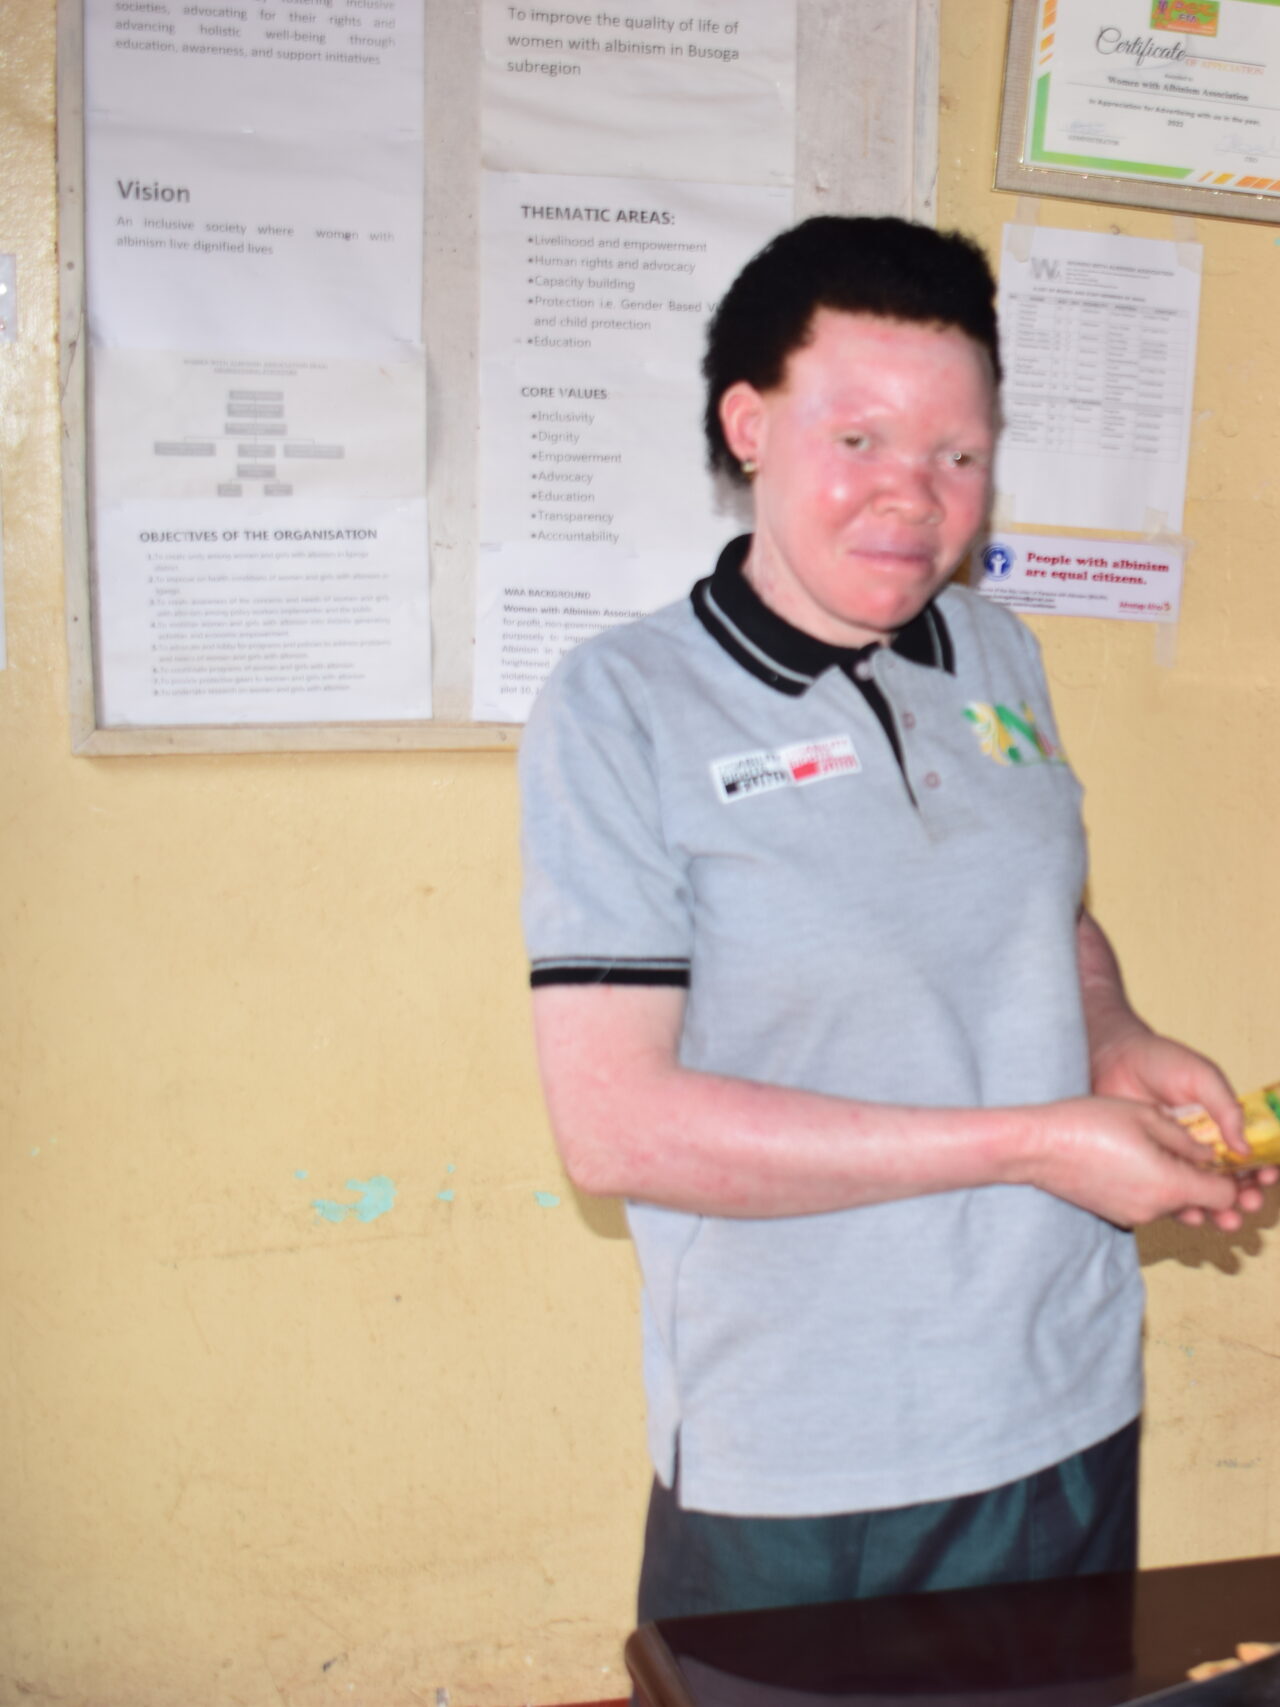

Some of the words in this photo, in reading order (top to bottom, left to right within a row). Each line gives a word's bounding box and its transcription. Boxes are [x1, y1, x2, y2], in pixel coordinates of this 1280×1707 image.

[183, 6, 248, 21] advocating
[260, 9, 276, 21] for
[289, 11, 317, 23] their
[329, 14, 362, 28] rights
[374, 18, 396, 29] and
[508, 8, 525, 21] To
[531, 9, 592, 26] improve
[597, 12, 620, 27] the
[625, 15, 676, 34] quality
[679, 18, 694, 32] of
[698, 19, 720, 34] life
[724, 21, 739, 35] of
[115, 19, 176, 35] advancing
[199, 23, 242, 37] holistic
[265, 28, 326, 44] well-being
[349, 34, 396, 48] through
[251, 46, 274, 59] and
[276, 49, 322, 63] support
[325, 51, 381, 65] initiatives
[508, 36, 563, 49] women
[568, 36, 600, 51] with
[604, 39, 666, 56] albinism
[671, 42, 683, 56] in
[688, 44, 739, 61] Busoga
[1096, 27, 1187, 67] Certificate
[507, 59, 581, 77] subregion
[1107, 75, 1139, 88] Women
[1142, 80, 1160, 90] with
[1162, 83, 1200, 96] Albinism
[1203, 88, 1249, 102] Association
[116, 179, 191, 203] Vision
[521, 205, 611, 223] THEMATIC
[616, 210, 676, 225] AREAS:
[117, 215, 133, 227] An
[144, 217, 194, 231] inclusive
[206, 221, 247, 236] society
[257, 223, 294, 237] where
[316, 229, 358, 241] women
[369, 229, 395, 242] with
[117, 236, 167, 249] albinism
[169, 238, 190, 250] live
[193, 240, 244, 254] dignified
[247, 242, 274, 256] lives
[534, 235, 594, 249] Livelihood
[598, 238, 619, 249] and
[624, 240, 707, 253] empowerment
[534, 255, 577, 268] Human
[581, 257, 613, 271] rights
[617, 258, 638, 270] and
[642, 260, 695, 275] advocacy
[534, 276, 584, 290] Capacity
[588, 277, 635, 292] building
[534, 296, 594, 309] Protection
[620, 299, 663, 312] Gender
[668, 300, 702, 313] Based
[534, 317, 556, 328] and
[560, 317, 586, 329] child
[591, 318, 651, 332] protection
[534, 336, 591, 348] Education
[521, 387, 556, 398] CORE
[538, 411, 595, 426] Inclusivity
[538, 431, 580, 445] Dignity
[538, 451, 622, 465] Empowerment
[538, 471, 593, 485] Advocacy
[538, 491, 595, 502] Education
[538, 510, 614, 525] Transparency
[139, 530, 218, 544] OBJECTIVES
[222, 530, 242, 542] OF
[245, 530, 269, 541] THE
[273, 529, 378, 541] ORGANISATION
[538, 530, 619, 545] Accountability
[1026, 552, 1073, 567] People
[1076, 556, 1108, 569] with
[1112, 558, 1169, 573] albinism
[1025, 567, 1047, 578] are
[1051, 569, 1089, 582] equal
[1092, 572, 1148, 586] citizens.
[528, 589, 591, 600] BACKGROUND
[503, 604, 538, 614] Women
[540, 605, 561, 615] with
[563, 606, 601, 616] Albinism
